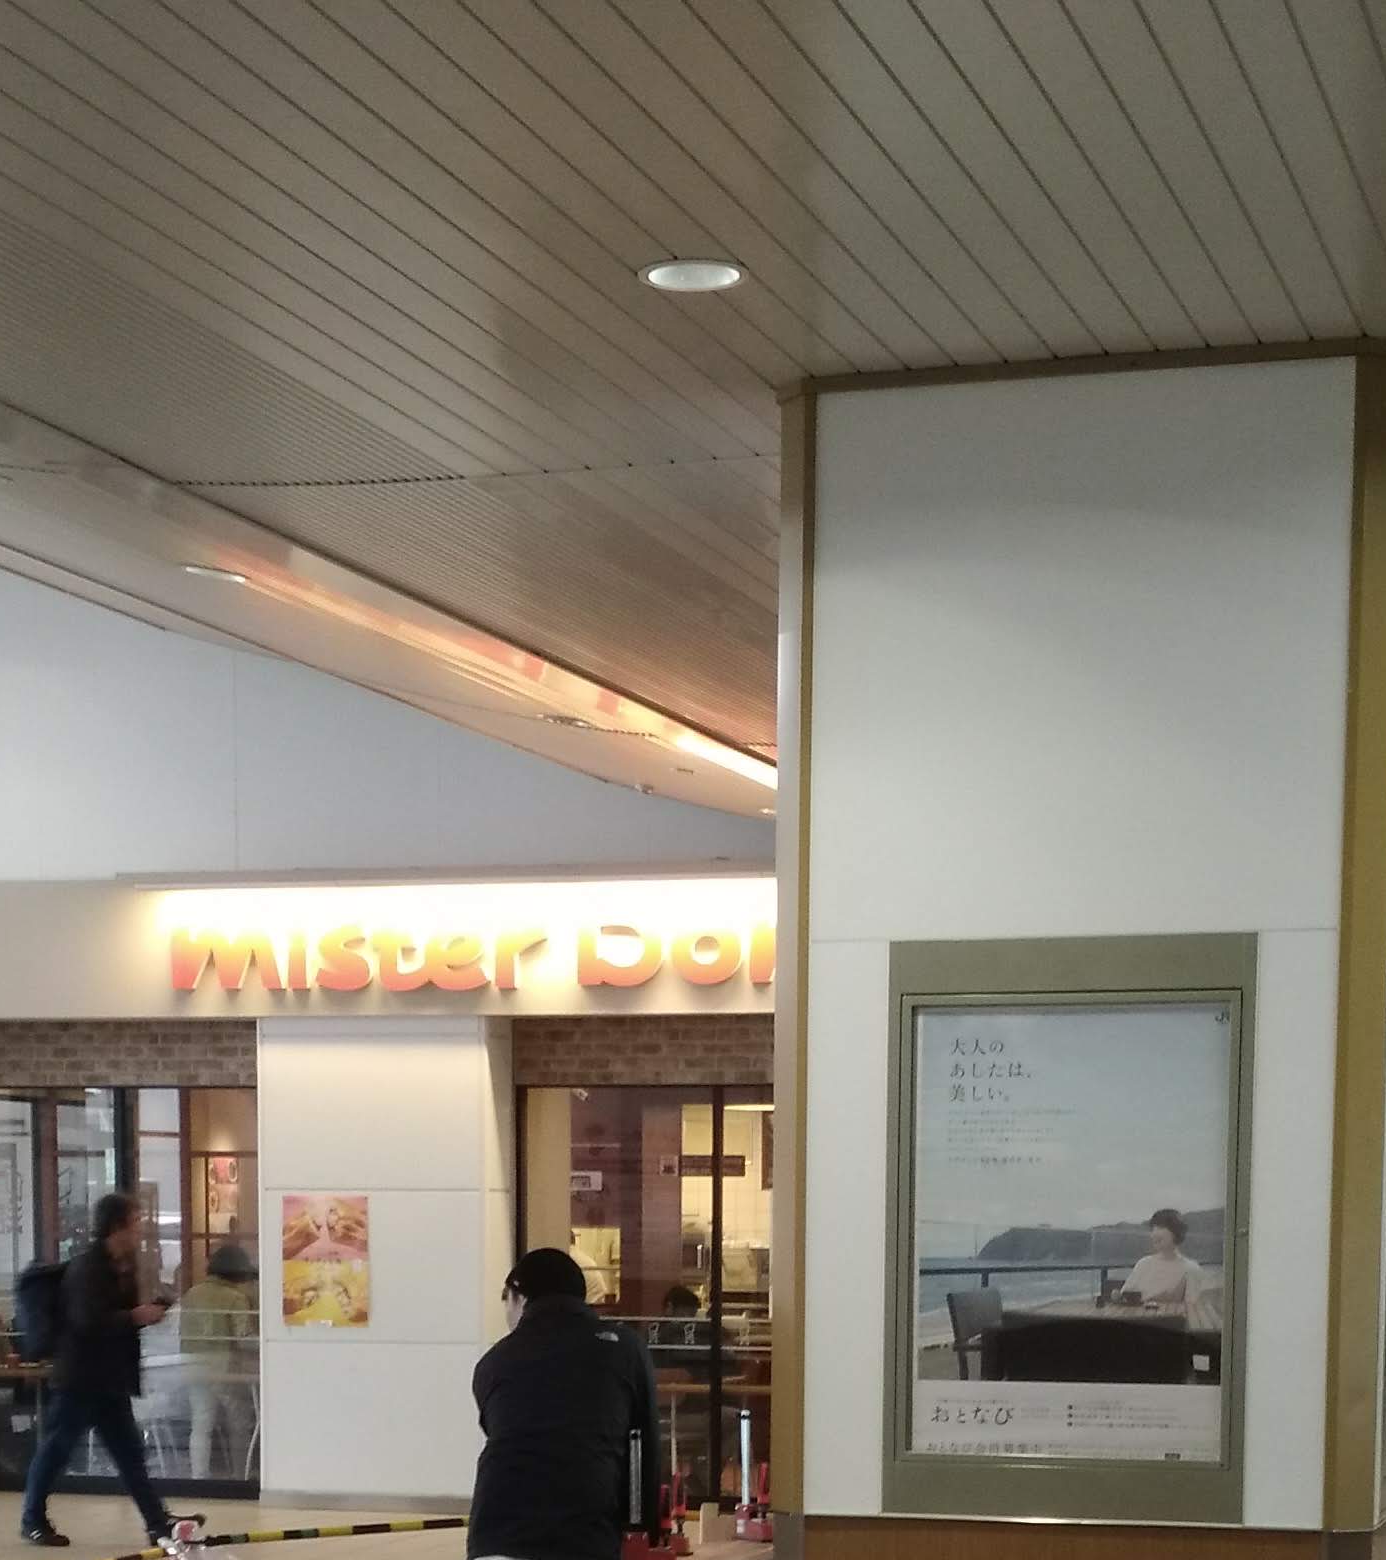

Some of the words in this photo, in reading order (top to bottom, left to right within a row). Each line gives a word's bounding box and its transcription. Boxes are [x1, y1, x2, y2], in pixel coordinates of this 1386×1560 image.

[169, 920, 548, 993] Mister
[949, 1038, 1005, 1056] 大人の
[931, 1405, 1015, 1425] おとなび
